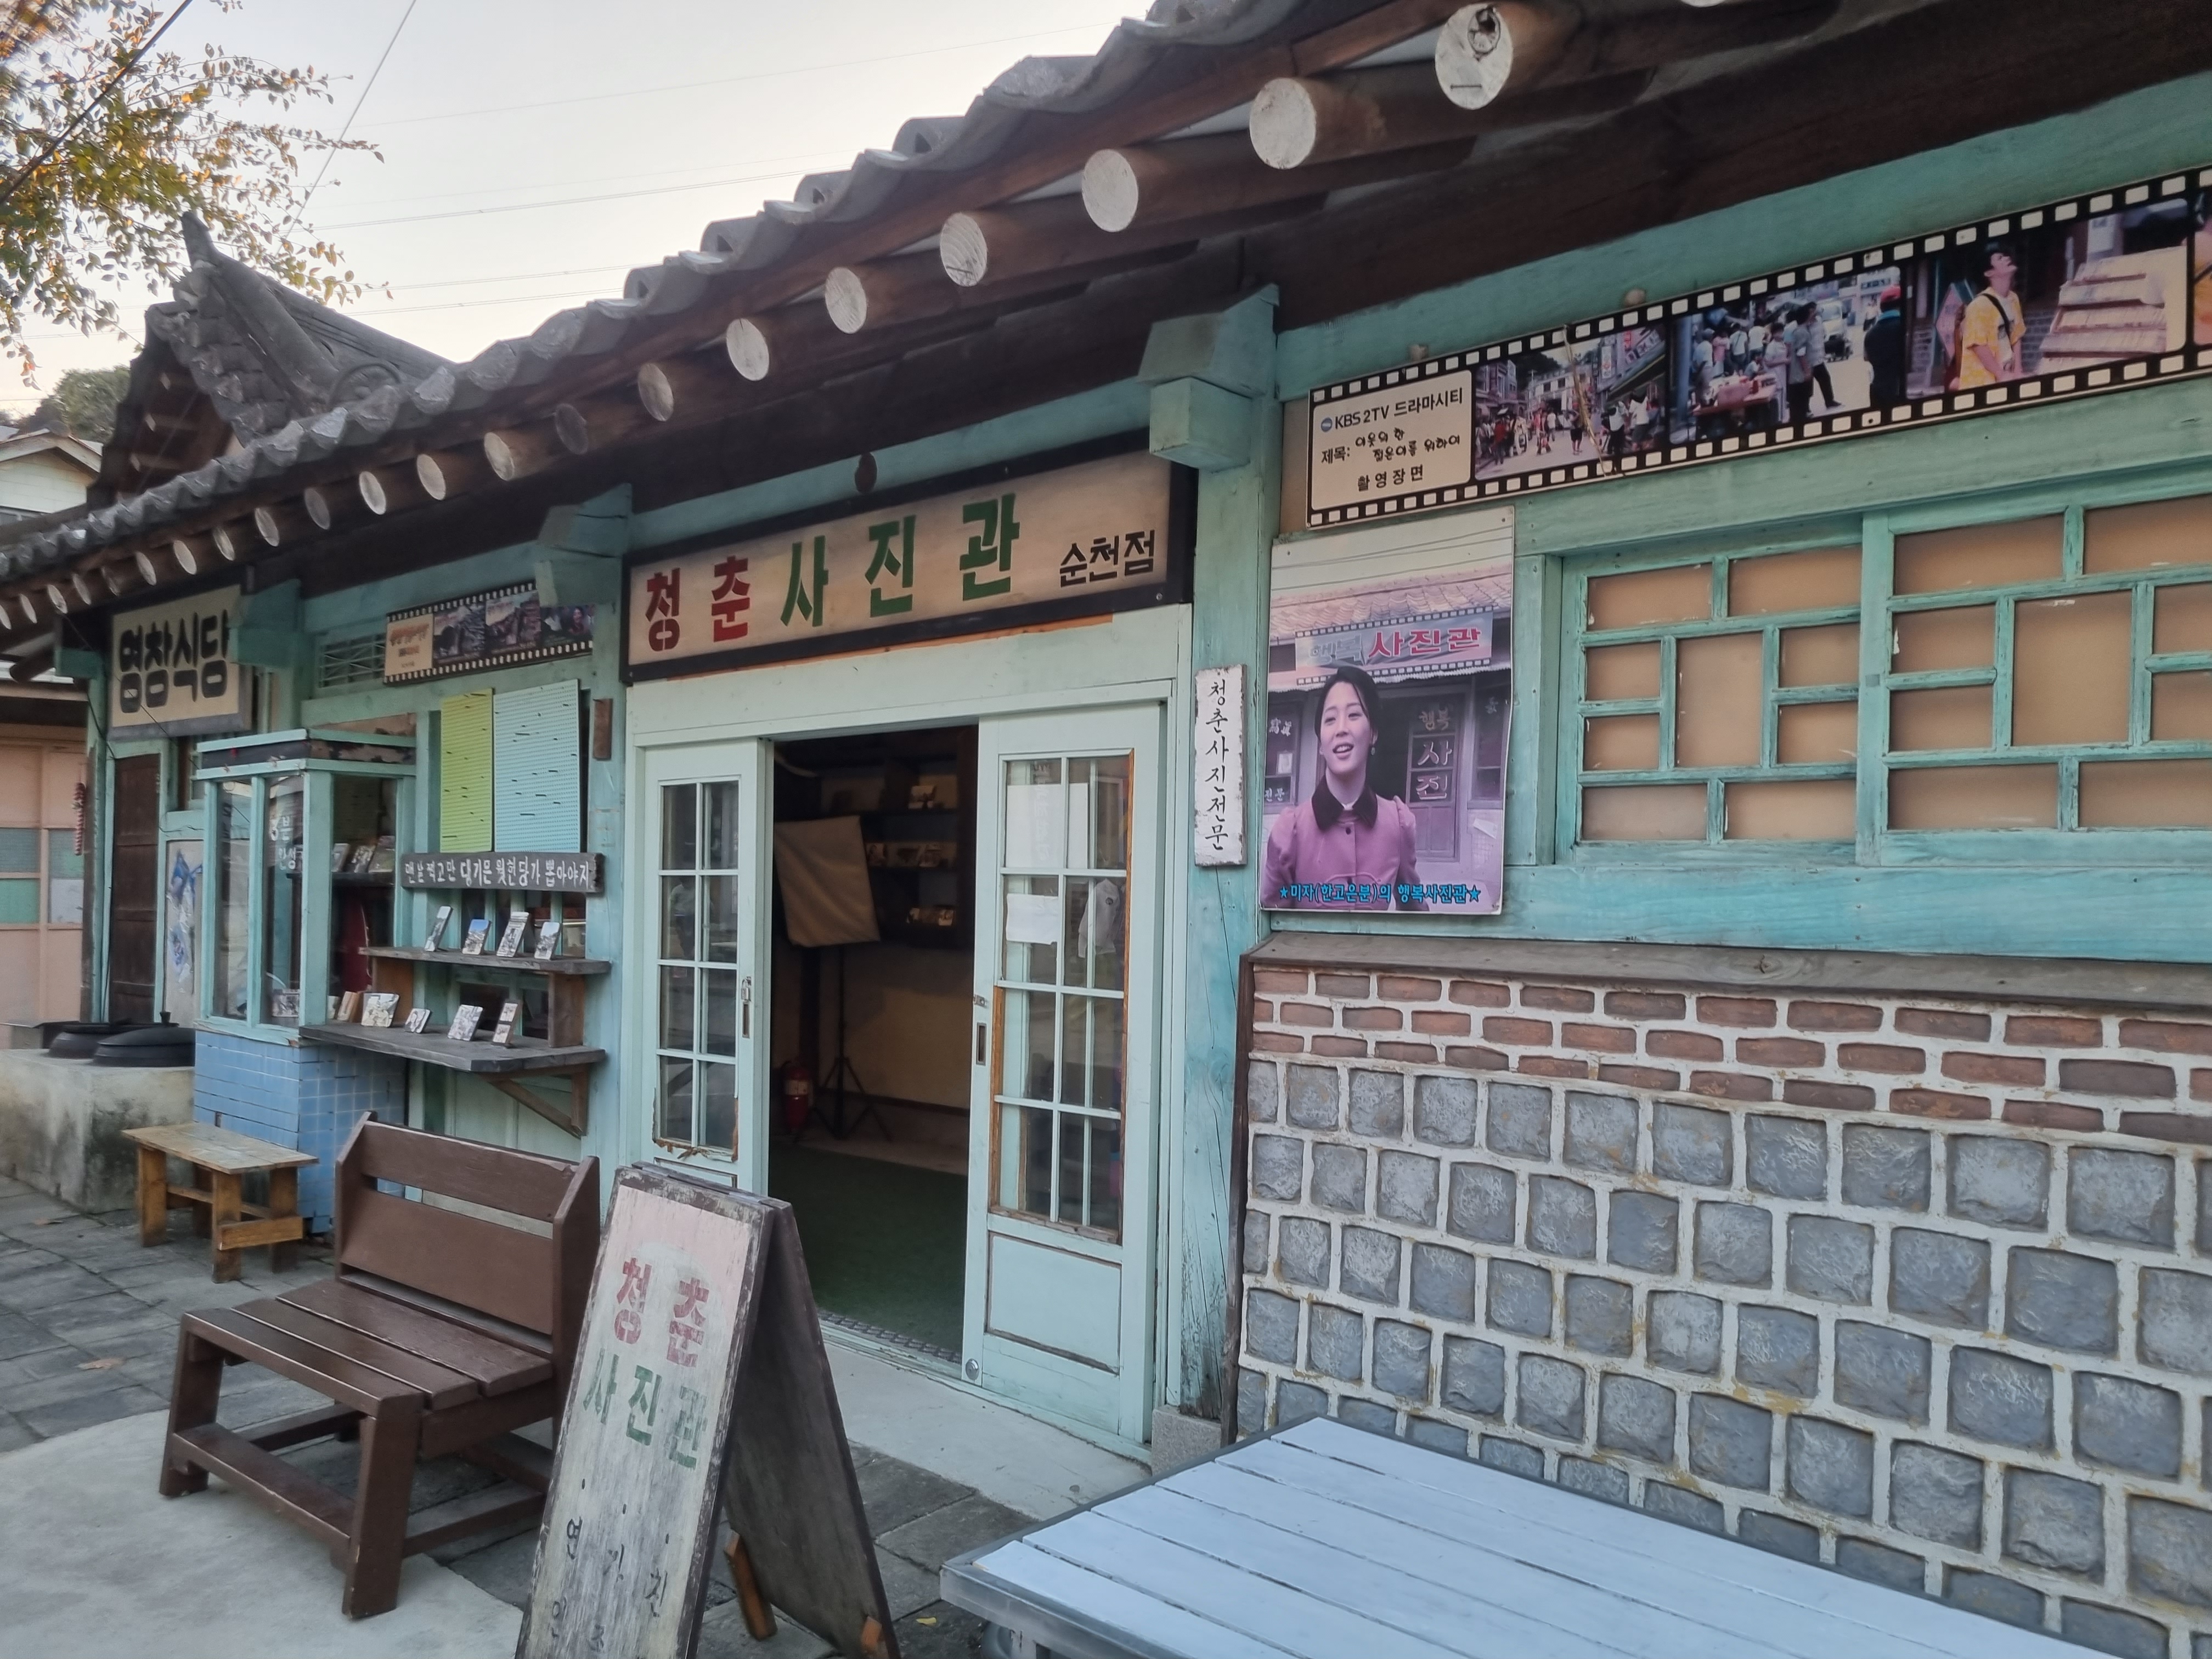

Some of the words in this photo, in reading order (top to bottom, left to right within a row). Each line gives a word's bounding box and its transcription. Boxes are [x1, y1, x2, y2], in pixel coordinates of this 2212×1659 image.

[1393, 387, 1464, 417] 드라마시티
[1355, 431, 1389, 448] 이웃의
[1393, 427, 1405, 441] 한
[1372, 440, 1418, 462] 젊은이를
[1424, 435, 1460, 453] 위하여
[1321, 445, 1351, 465] 제목:
[1059, 529, 1155, 589] 순천점
[119, 609, 228, 713] 영창식당
[1418, 706, 1451, 731] 행복
[544, 858, 589, 890] 뽑아야지
[1397, 884, 1469, 904] 행복사진관
[613, 1256, 712, 1368] 청춘
[582, 1347, 709, 1470] 사진관
